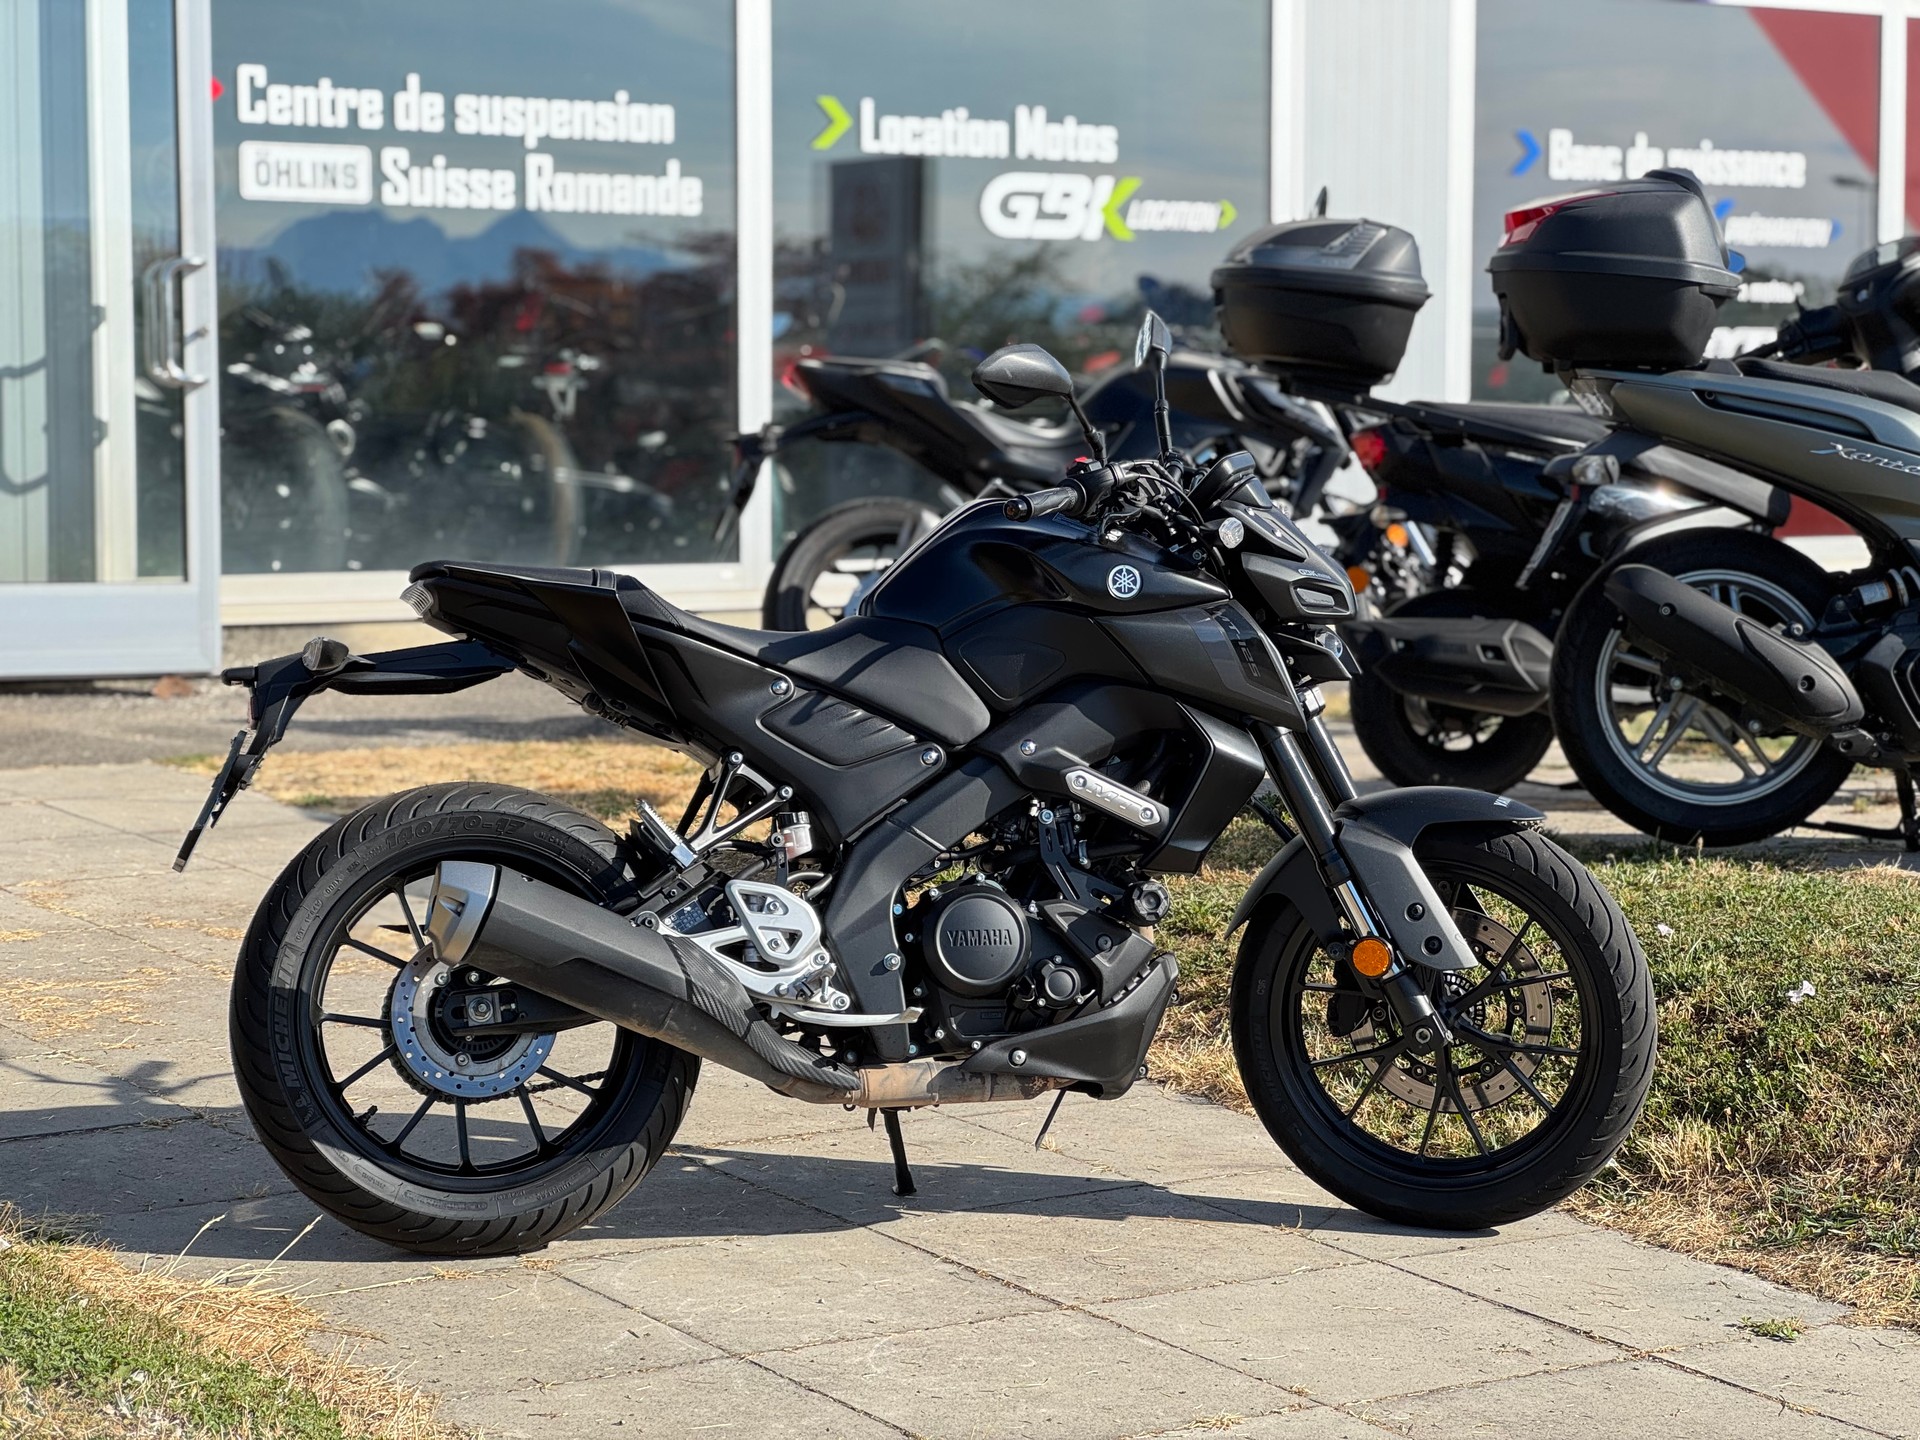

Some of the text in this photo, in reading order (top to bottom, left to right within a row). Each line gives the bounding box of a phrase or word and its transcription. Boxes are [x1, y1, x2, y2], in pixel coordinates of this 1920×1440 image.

[237, 63, 676, 150] Centre de suspension
[860, 97, 1119, 164] Location Motos
[254, 151, 359, 190] ÖHLINS
[381, 146, 703, 217] Suisse Romande
[1548, 128, 1623, 181] Banc
[384, 814, 527, 851] 140/70-17
[947, 929, 1013, 947] YAMAHA
[274, 948, 301, 1088] MICHELIN
